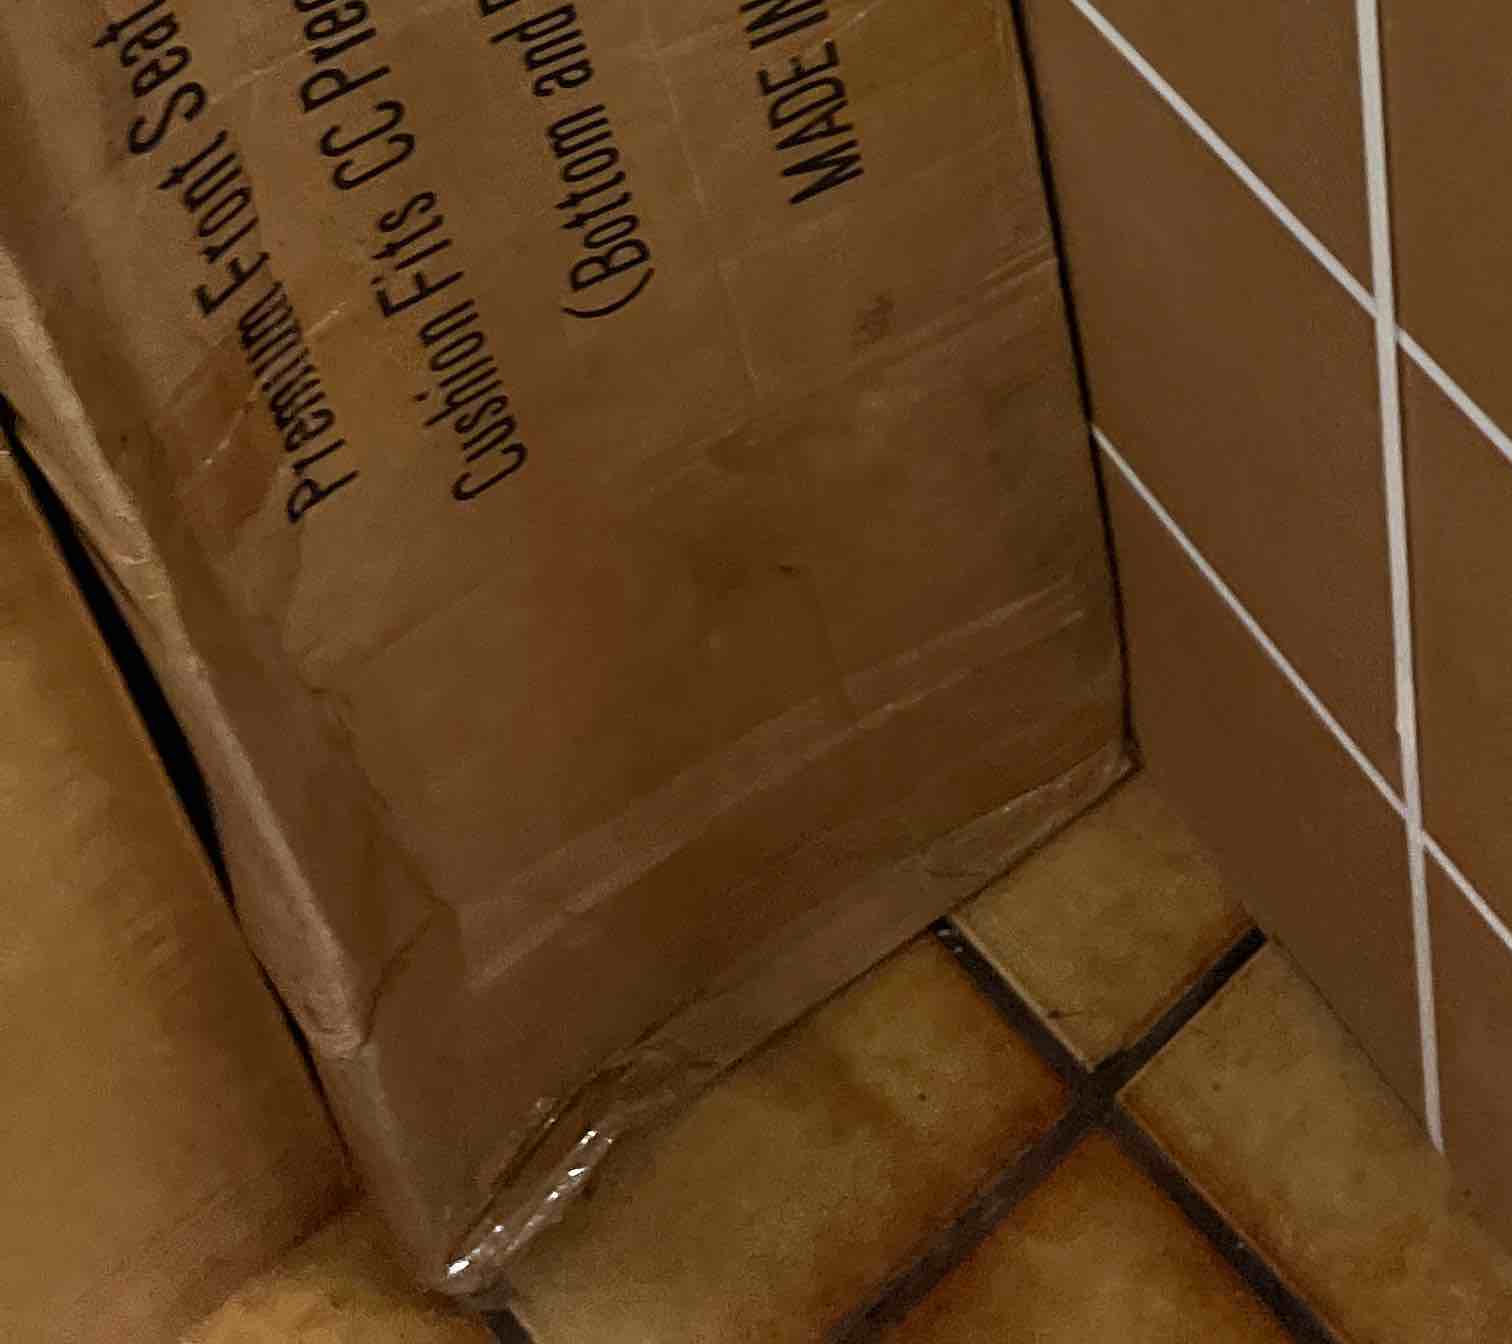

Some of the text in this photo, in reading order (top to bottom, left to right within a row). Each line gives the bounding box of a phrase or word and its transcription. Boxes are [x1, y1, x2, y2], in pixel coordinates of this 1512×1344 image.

[492, 5, 594, 99] and
[758, 39, 865, 206] MADE
[160, 131, 270, 319] Front
[320, 100, 416, 190] CC
[547, 105, 655, 320] (Bottom
[375, 190, 463, 317] Fits
[237, 282, 359, 524] Premium
[418, 298, 527, 502] Cushion
